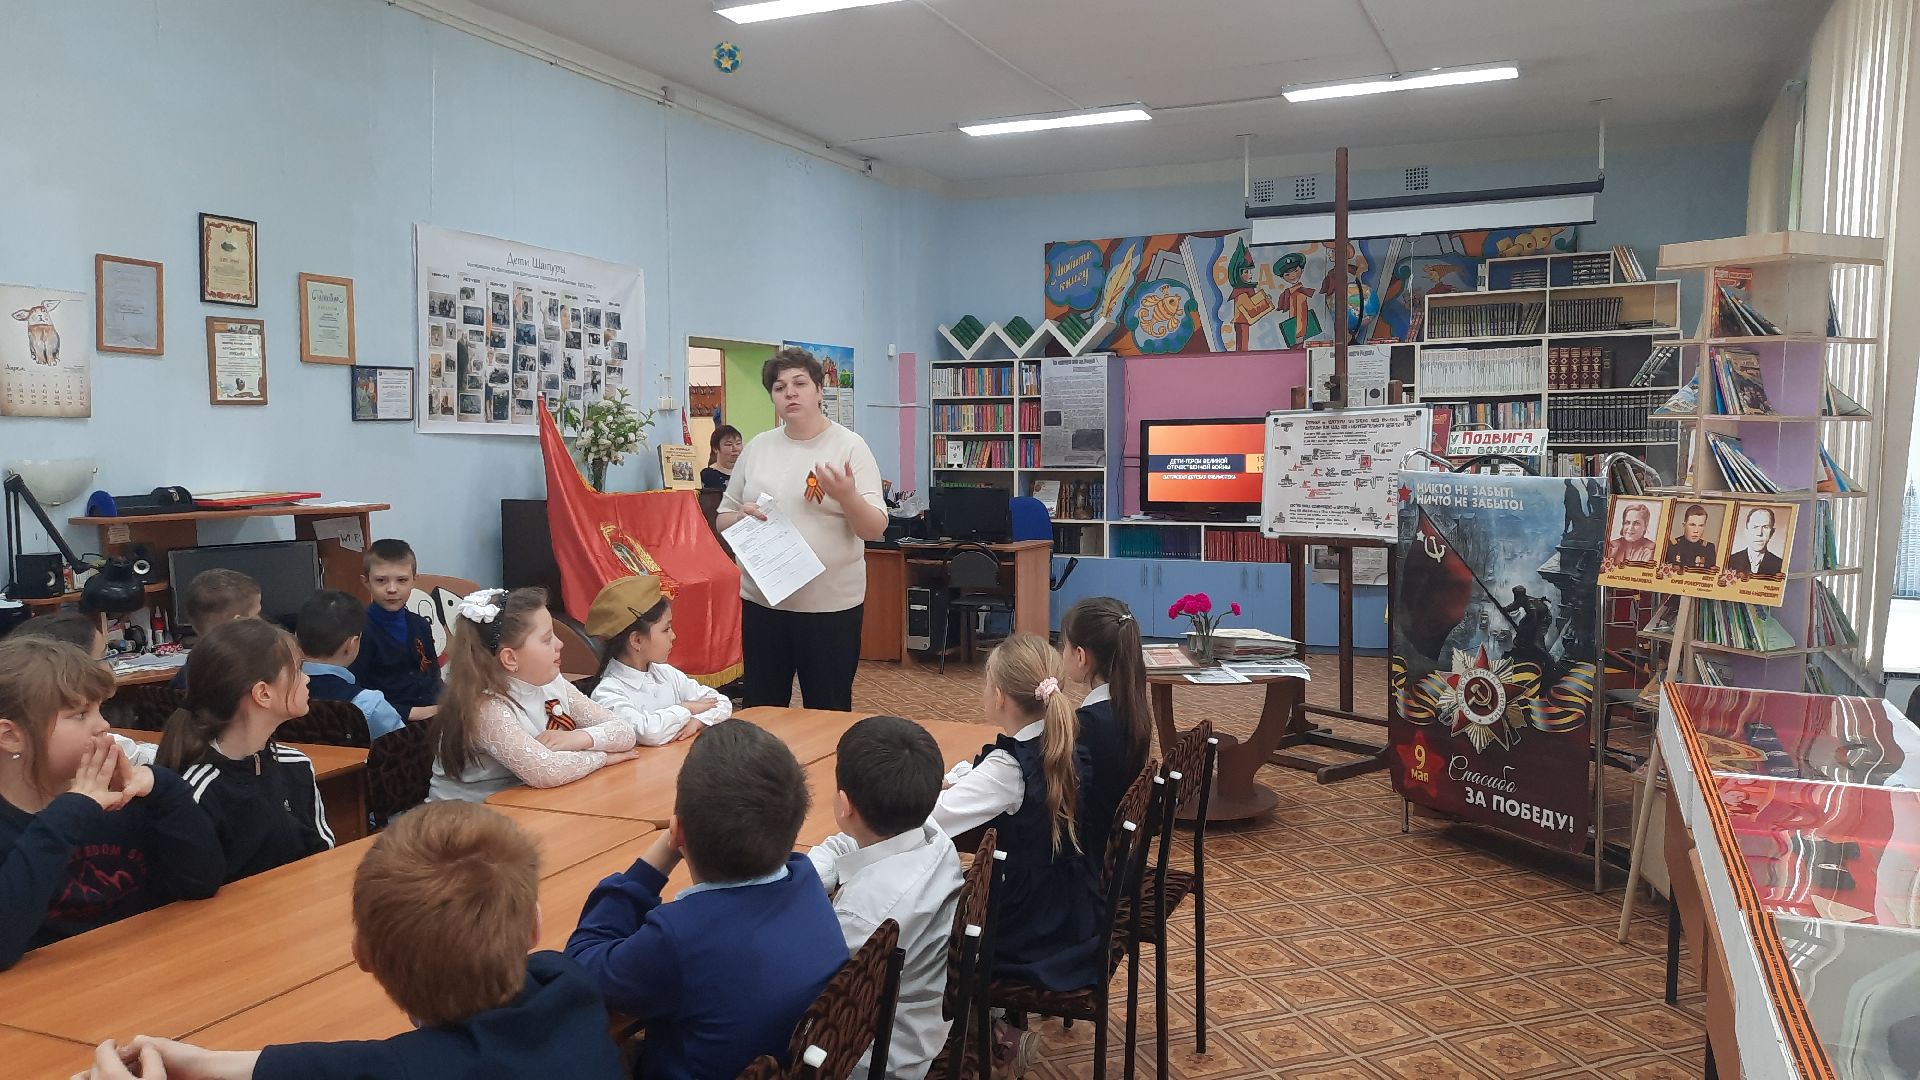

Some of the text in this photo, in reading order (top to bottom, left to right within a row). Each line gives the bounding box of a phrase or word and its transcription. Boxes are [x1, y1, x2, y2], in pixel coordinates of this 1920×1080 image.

[506, 252, 530, 268] Дети
[1059, 268, 1089, 293] книгу
[1451, 434, 1460, 445] У
[1449, 447, 1472, 455] НЕТ
[1416, 483, 1514, 498] НИКТО НЕ ЗАБЫТ!
[1416, 494, 1524, 511] НИЧТО НЕ ЗАБЫТО!
[1414, 744, 1426, 769] 9
[1448, 752, 1518, 794] Спасибо
[1465, 786, 1576, 834] ЗА ПОБЕДУ!
